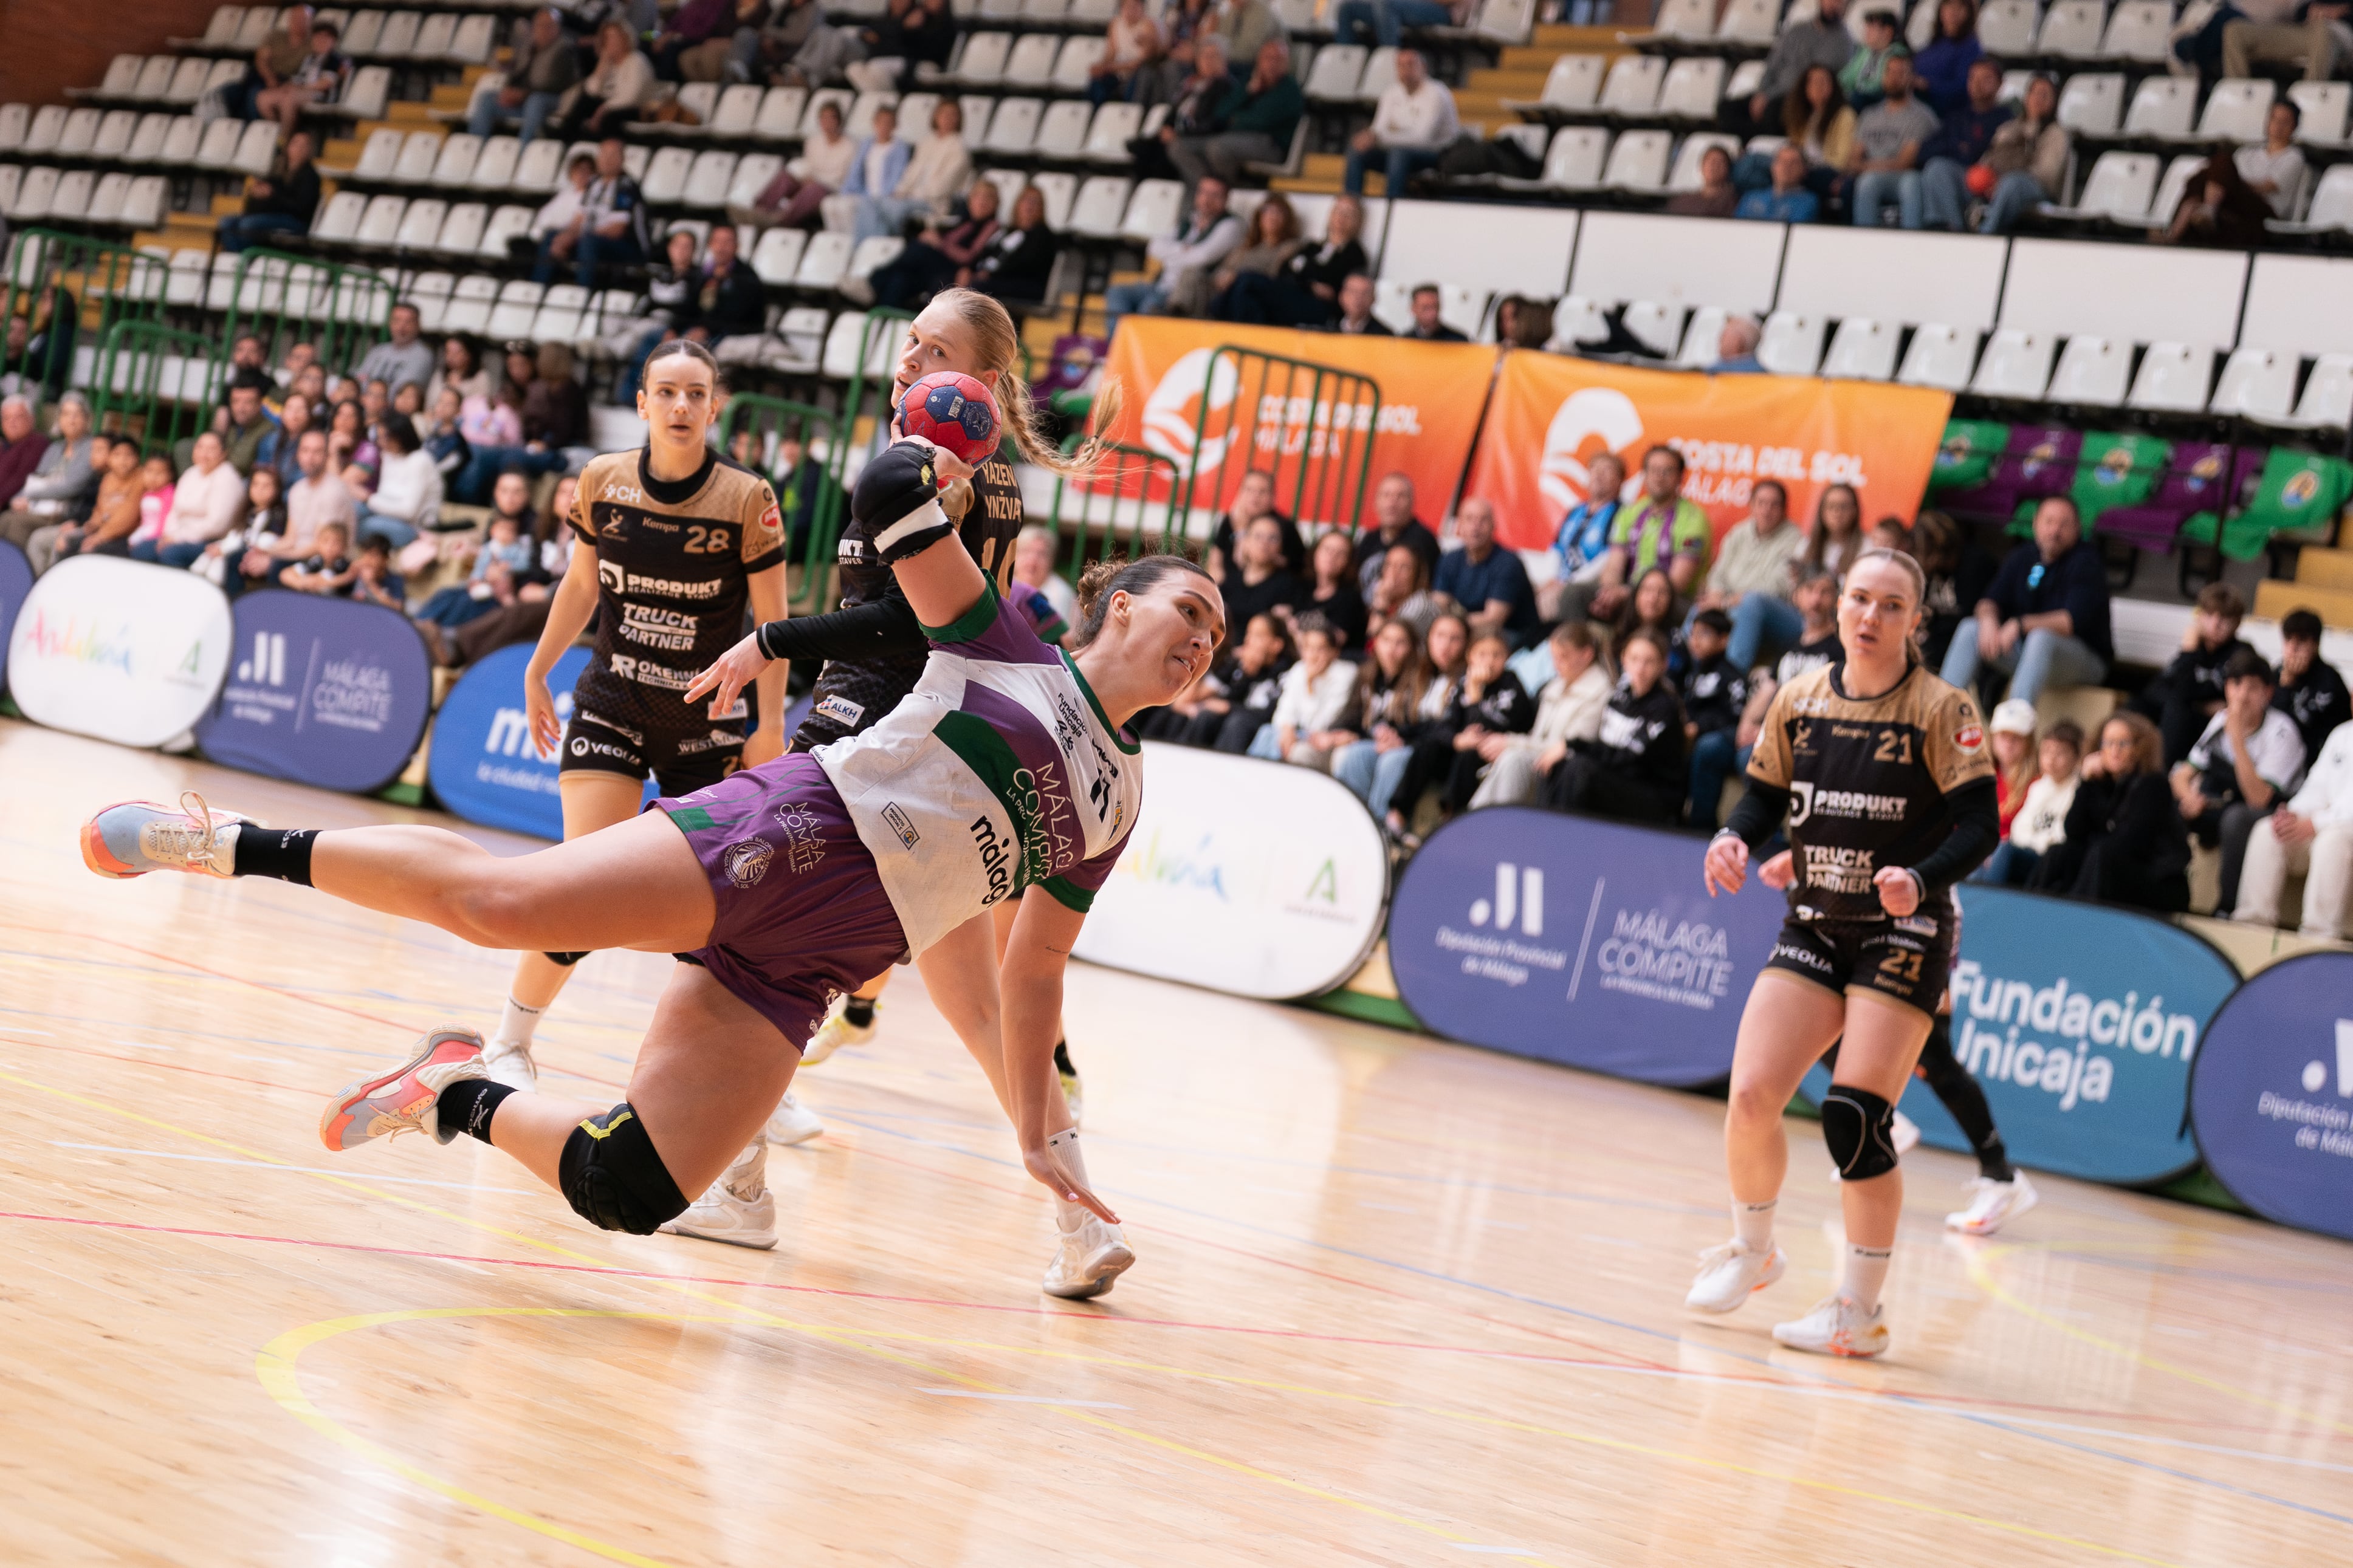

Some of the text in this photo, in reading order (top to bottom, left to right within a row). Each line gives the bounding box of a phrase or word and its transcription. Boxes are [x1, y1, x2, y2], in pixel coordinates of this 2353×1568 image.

[1756, 445, 1806, 480] DEL
[1809, 450, 1868, 487] SOL
[1680, 470, 1754, 508] ÁLAG
[642, 516, 680, 533] Kempa
[683, 525, 730, 555] 28
[627, 573, 722, 597] PRODUKT
[622, 601, 699, 630] TRUCK
[618, 623, 695, 651] PARTNER
[639, 674, 681, 688] TECHNIKA
[831, 702, 858, 719] ALKH
[1059, 704, 1082, 738] Unicaja
[590, 741, 642, 765] VEOLIA
[1873, 729, 1914, 765] 21
[1814, 789, 1908, 813] PRODUKT
[773, 813, 781, 822] LA
[778, 820, 796, 851] PROVINCI
[889, 807, 905, 827] PRODUCTO
[970, 814, 1010, 909] málag
[1802, 844, 1875, 868] TRUCK
[1805, 870, 1872, 894] PARTNER
[1612, 908, 1728, 959] MÁLAGA
[1597, 937, 1735, 996] COMPITE
[1778, 943, 1834, 974] VEOLIA
[1878, 947, 1925, 983] 21
[1951, 959, 2198, 1062] Fundación
